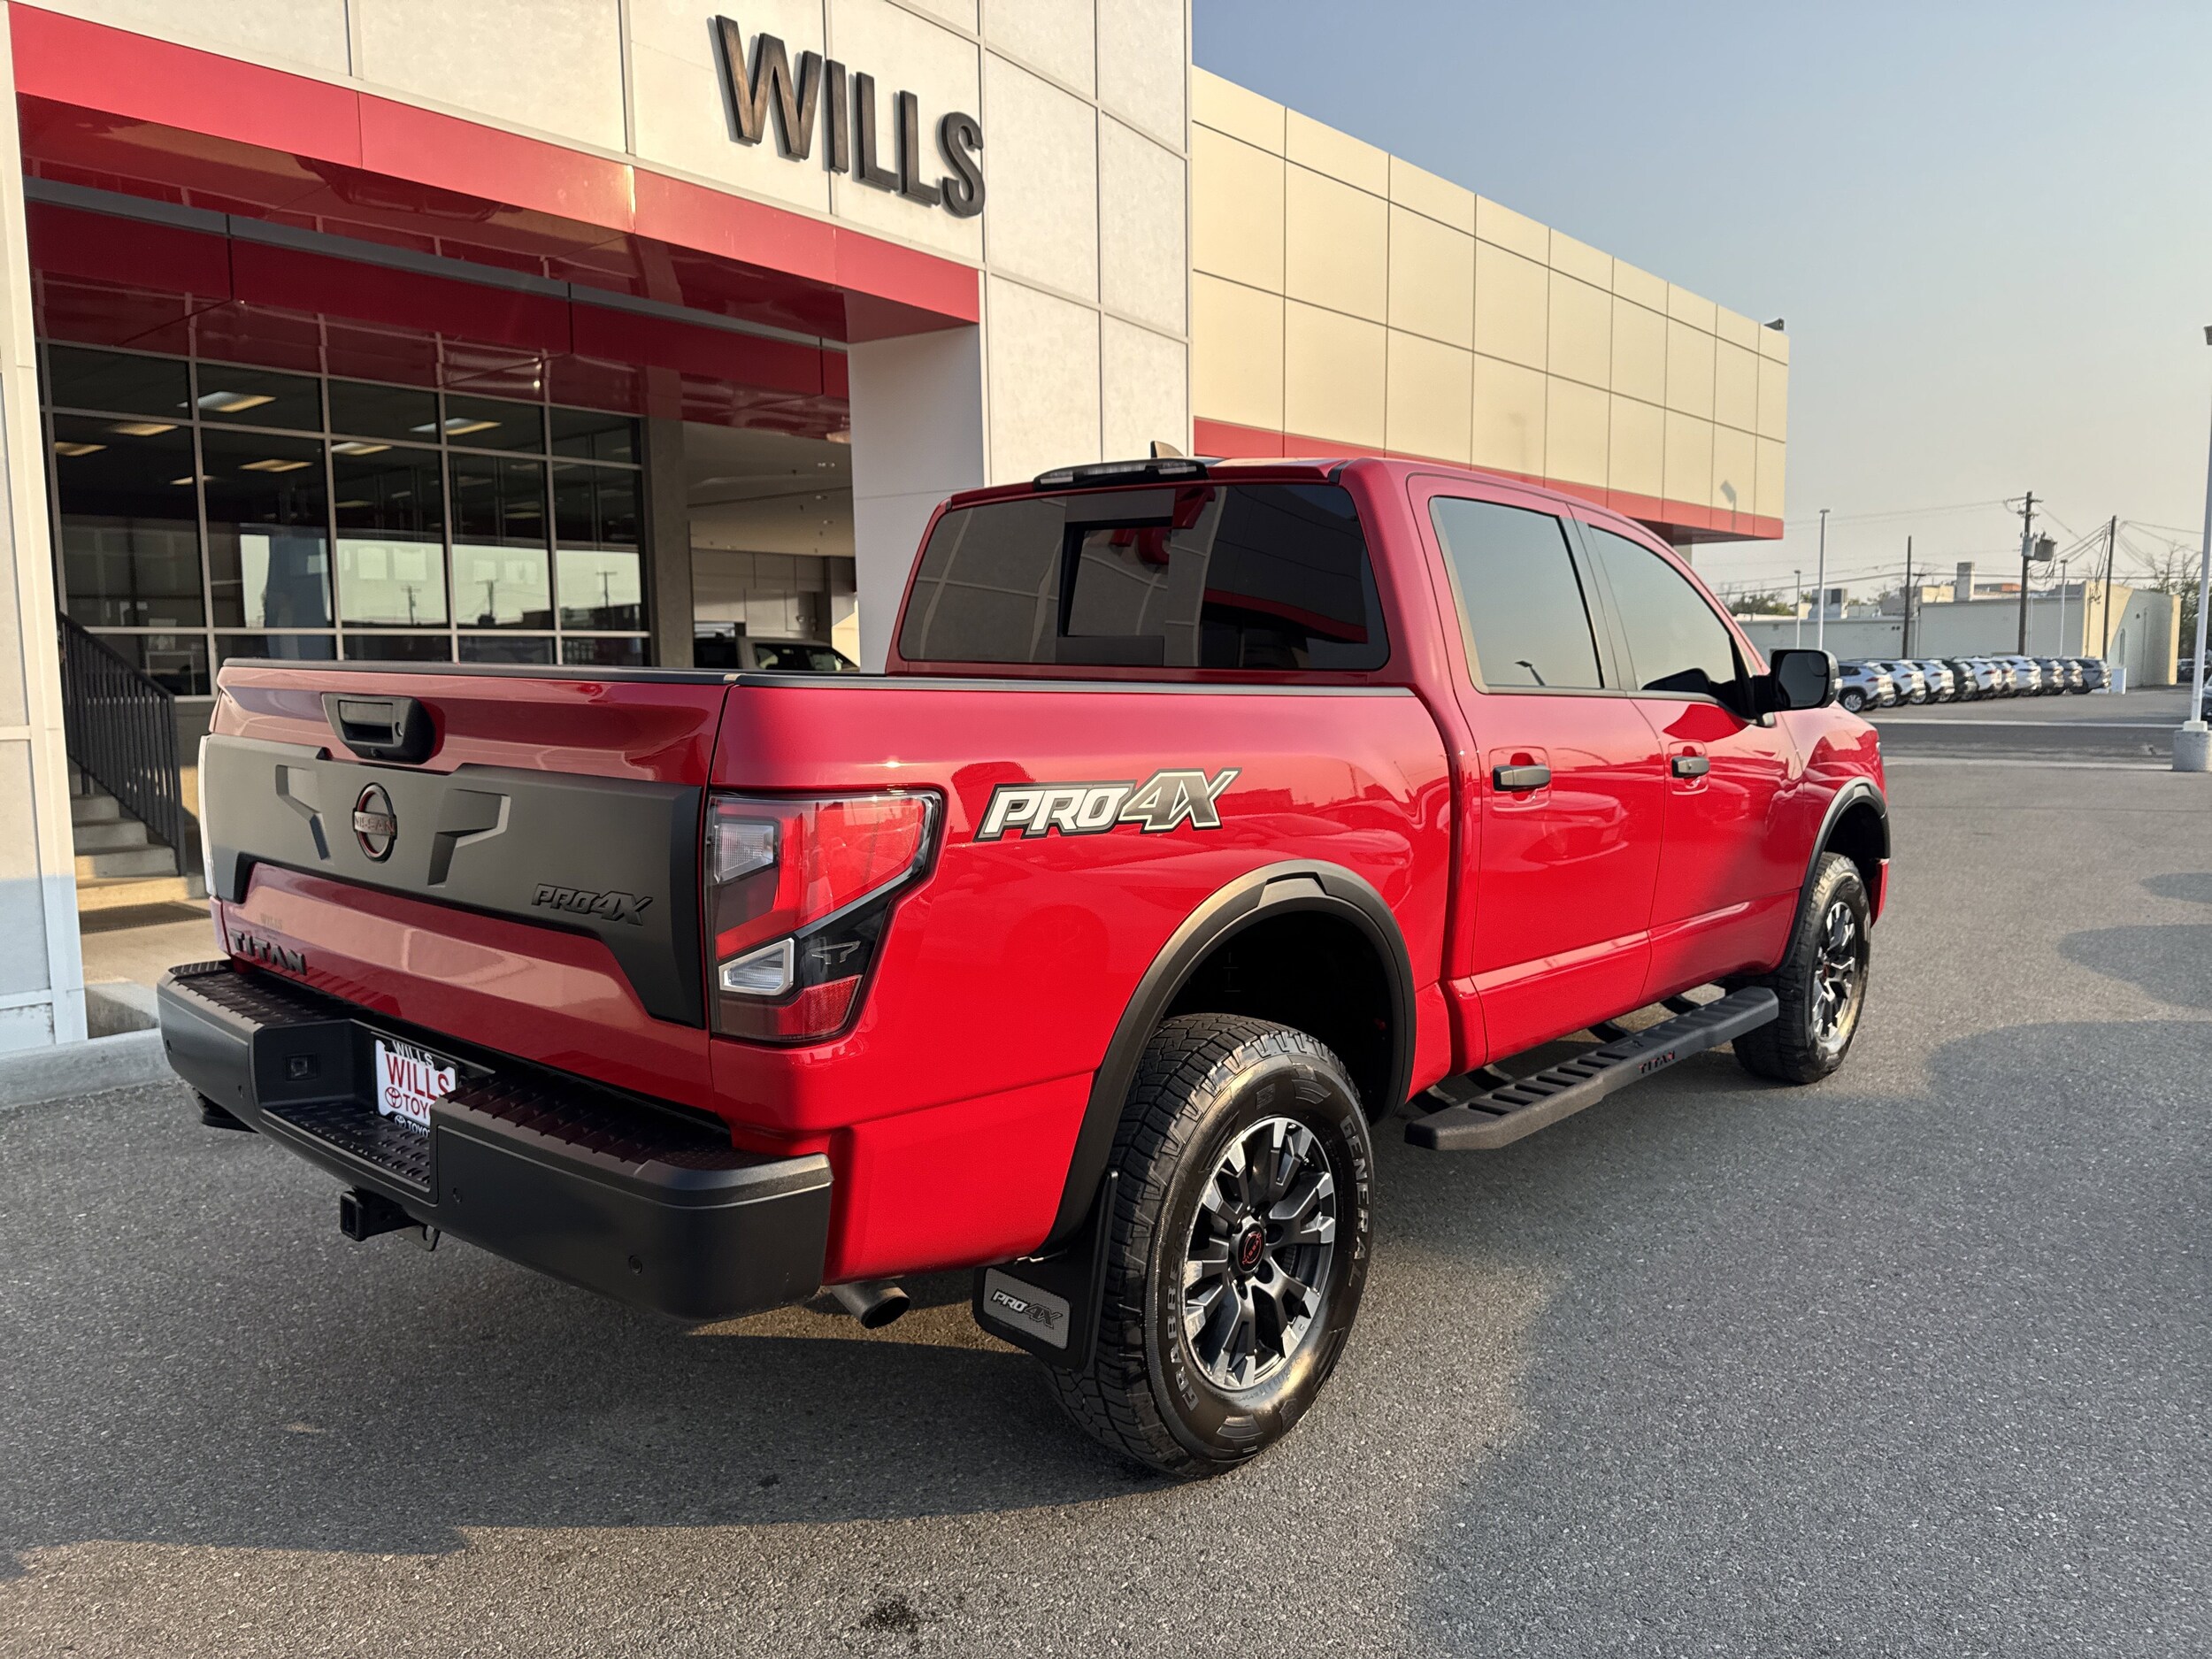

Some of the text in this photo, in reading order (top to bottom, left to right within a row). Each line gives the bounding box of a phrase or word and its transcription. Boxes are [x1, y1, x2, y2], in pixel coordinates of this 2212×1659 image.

[714, 14, 986, 219] WILLS
[354, 814, 396, 835] NISSAN
[974, 767, 1242, 841] PRO4X
[531, 883, 653, 926] PRO4X
[229, 927, 307, 976] TITAN
[392, 1040, 434, 1068] WILLS
[1638, 1050, 1675, 1074] TITAN
[386, 1053, 449, 1102] WILLS
[403, 1094, 432, 1119] TOY
[407, 1120, 431, 1138] TOYO
[1340, 1114, 1370, 1287] GENERAL
[991, 1288, 1064, 1330] PRO4X
